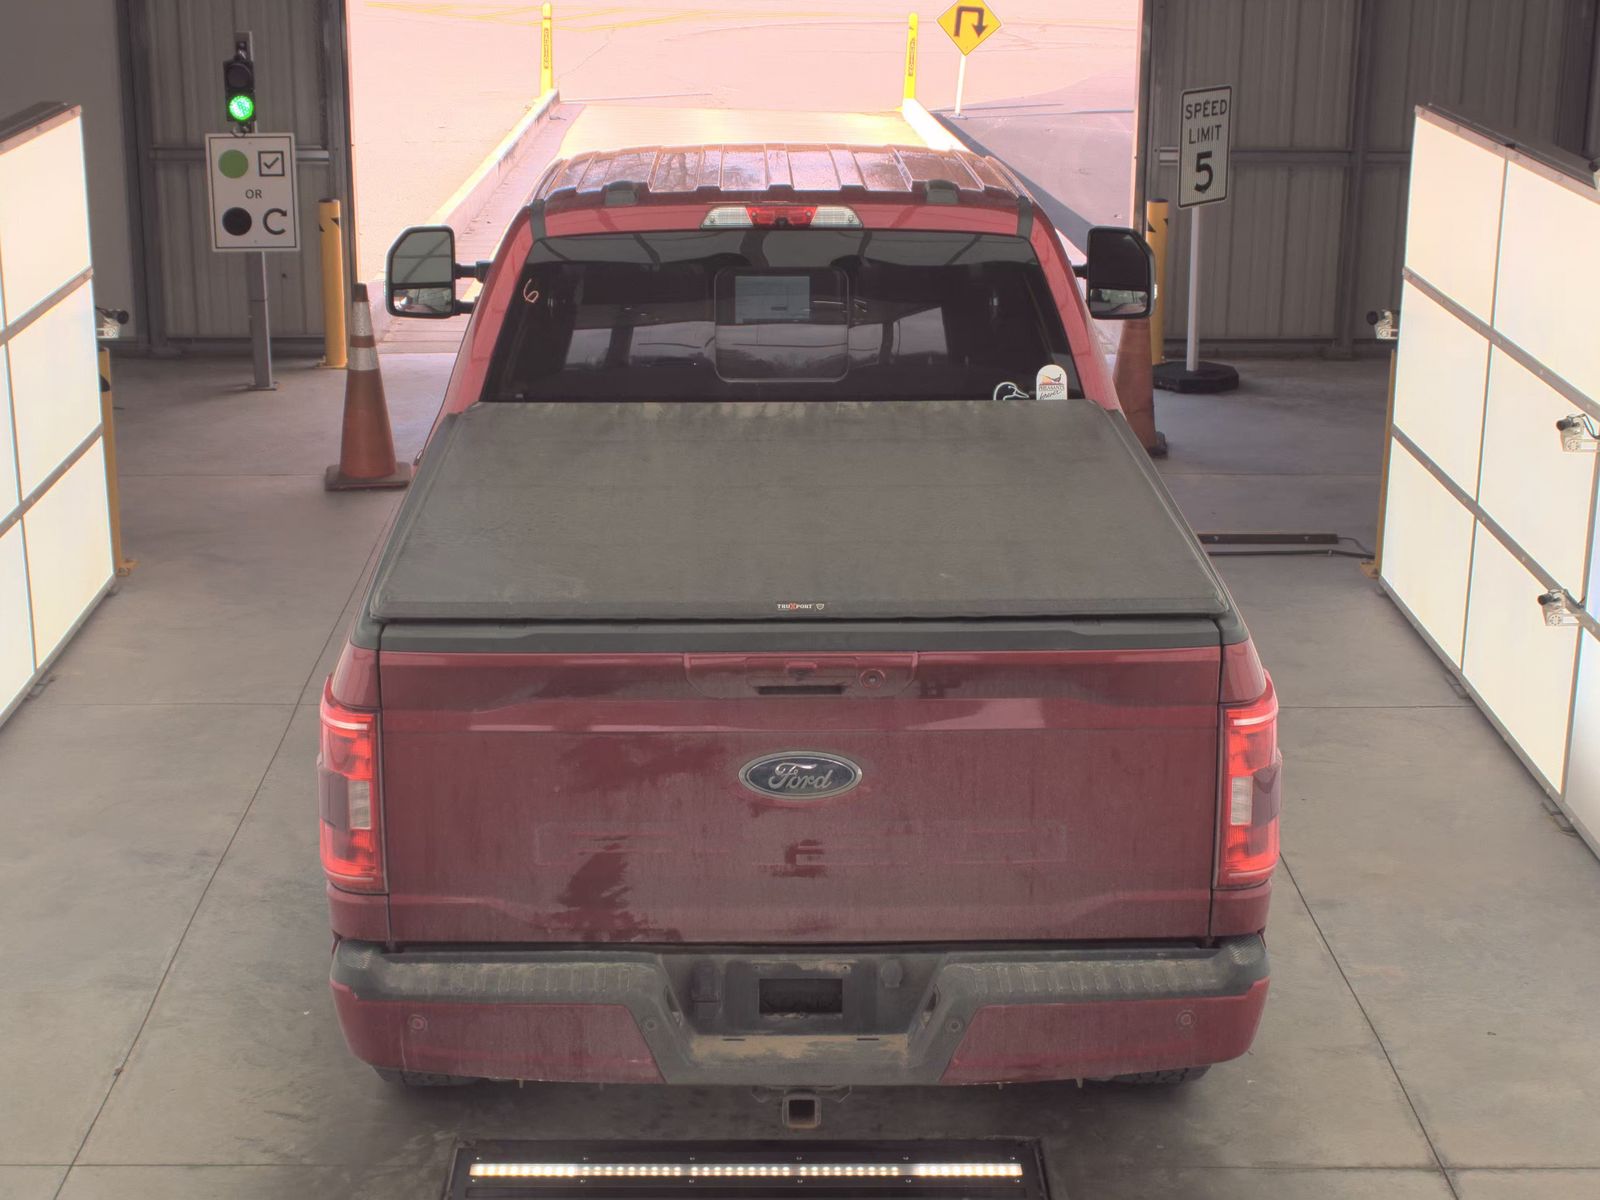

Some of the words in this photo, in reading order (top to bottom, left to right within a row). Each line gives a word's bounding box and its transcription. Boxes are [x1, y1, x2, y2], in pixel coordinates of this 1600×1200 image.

[1185, 99, 1228, 120] SPEED
[1189, 124, 1222, 144] LIMIT
[1194, 150, 1213, 194] 5
[245, 188, 262, 199] OR
[523, 278, 539, 303] 6
[768, 762, 834, 789] Ford
